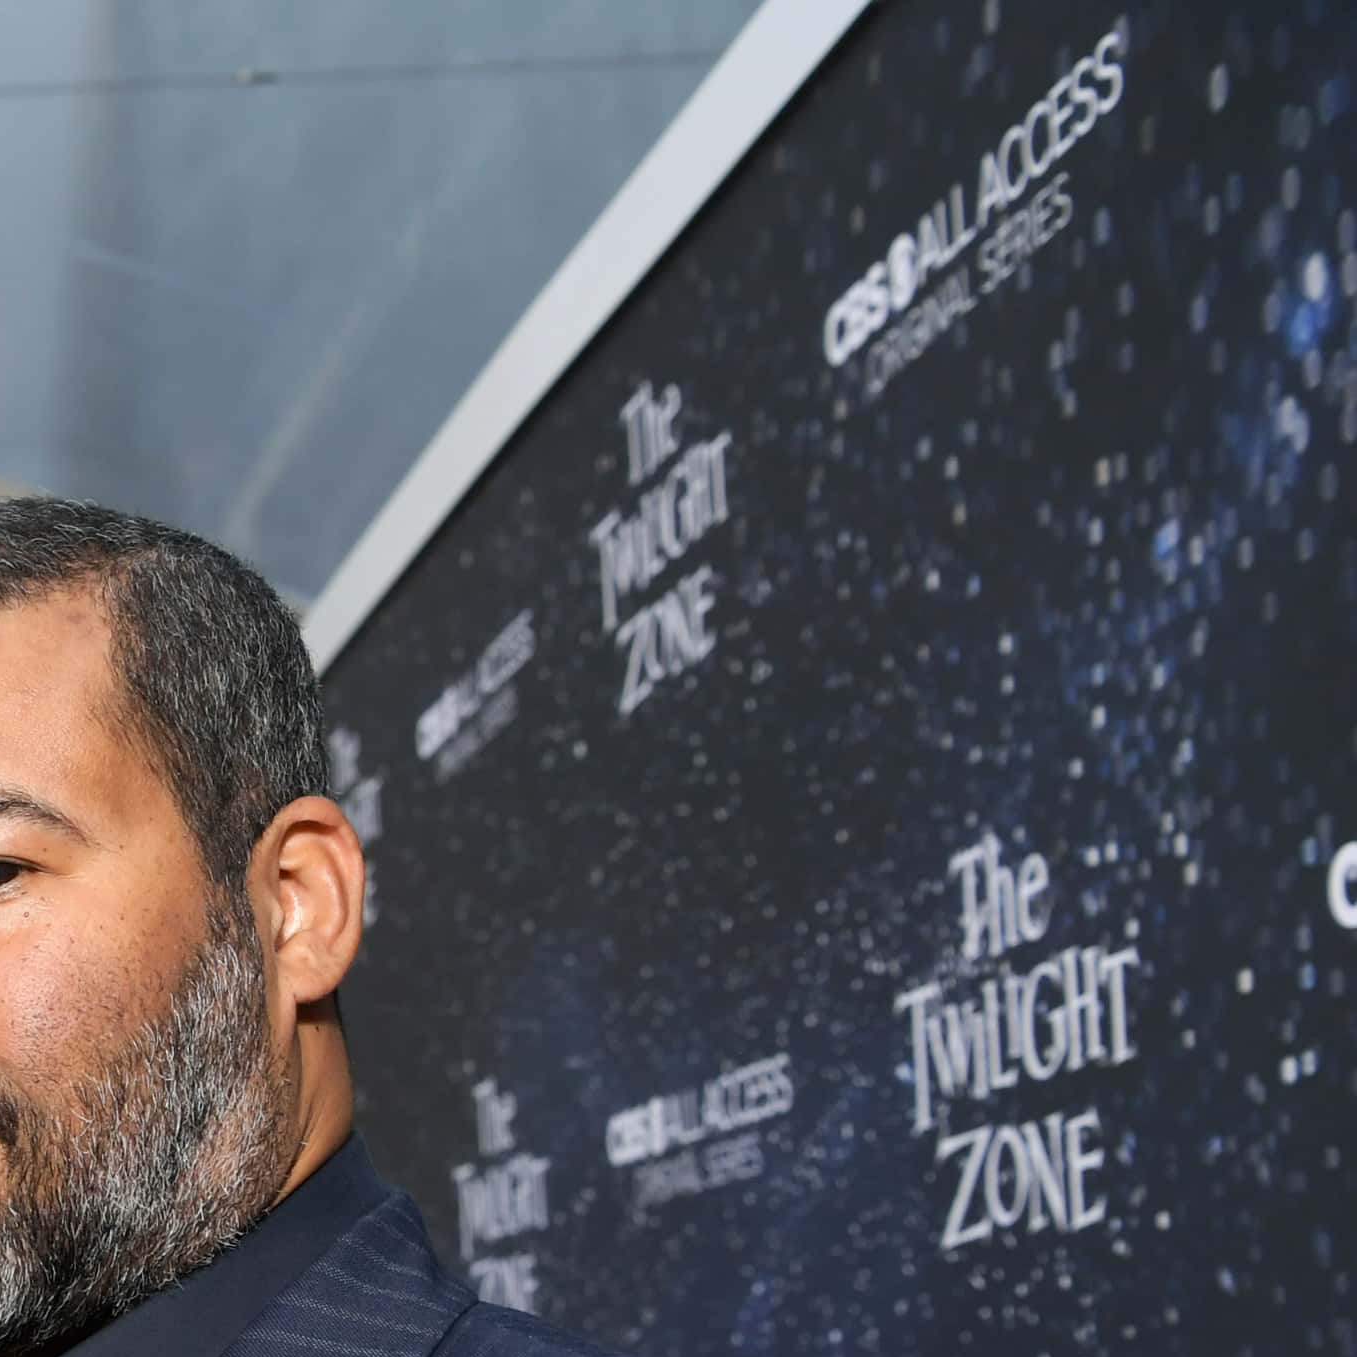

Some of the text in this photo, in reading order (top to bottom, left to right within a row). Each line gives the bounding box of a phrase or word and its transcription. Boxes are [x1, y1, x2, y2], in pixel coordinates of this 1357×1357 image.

[917, 183, 978, 288] ALL
[976, 31, 1124, 230] ACCESS
[977, 170, 1073, 294] SERIES
[619, 380, 682, 486] The
[615, 564, 716, 714] ZONE
[947, 832, 1051, 961] The
[894, 947, 1140, 1136] TWILIGHT
[936, 1107, 1108, 1250] ZONE
